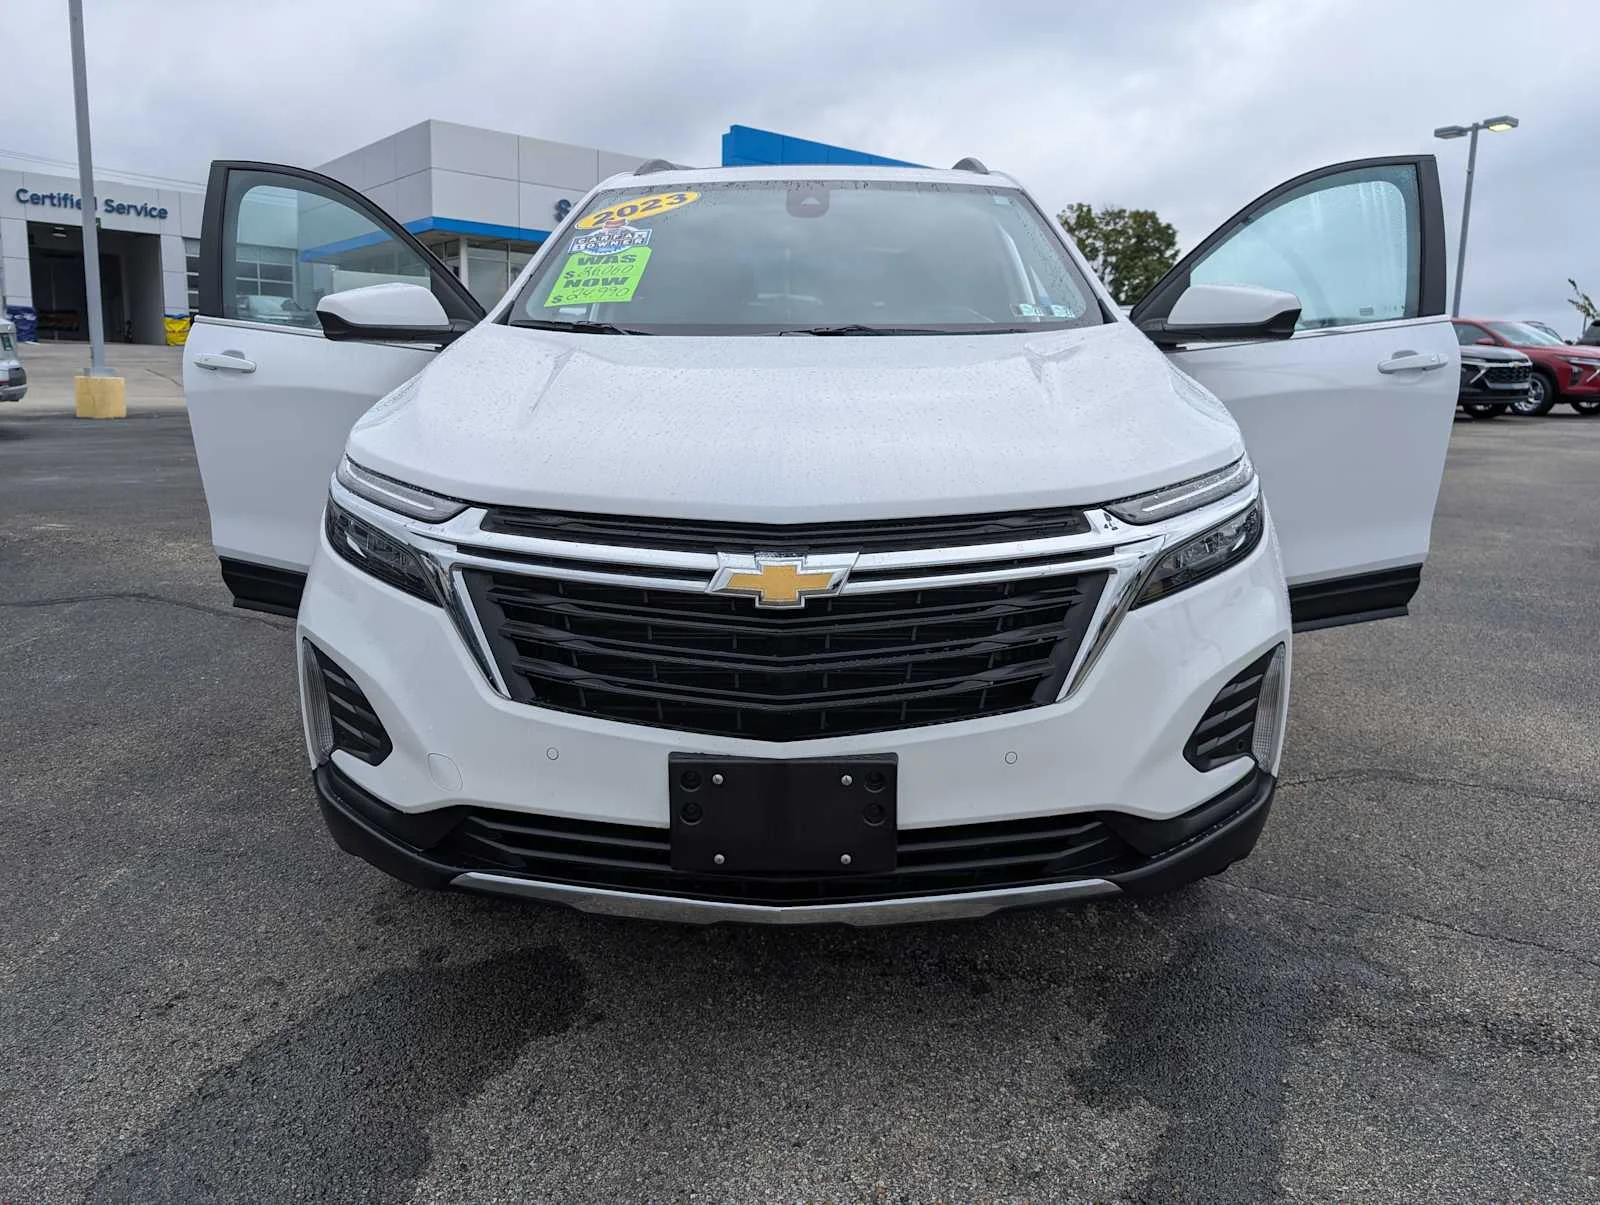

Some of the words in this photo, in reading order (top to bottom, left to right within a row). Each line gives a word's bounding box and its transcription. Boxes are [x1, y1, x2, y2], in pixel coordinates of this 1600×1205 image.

[16, 188, 98, 211] Certifie
[104, 199, 168, 219] Service
[591, 193, 687, 226] 2023
[586, 238, 644, 249] OWNER
[577, 254, 637, 266] WAS
[563, 276, 631, 288] NOW
